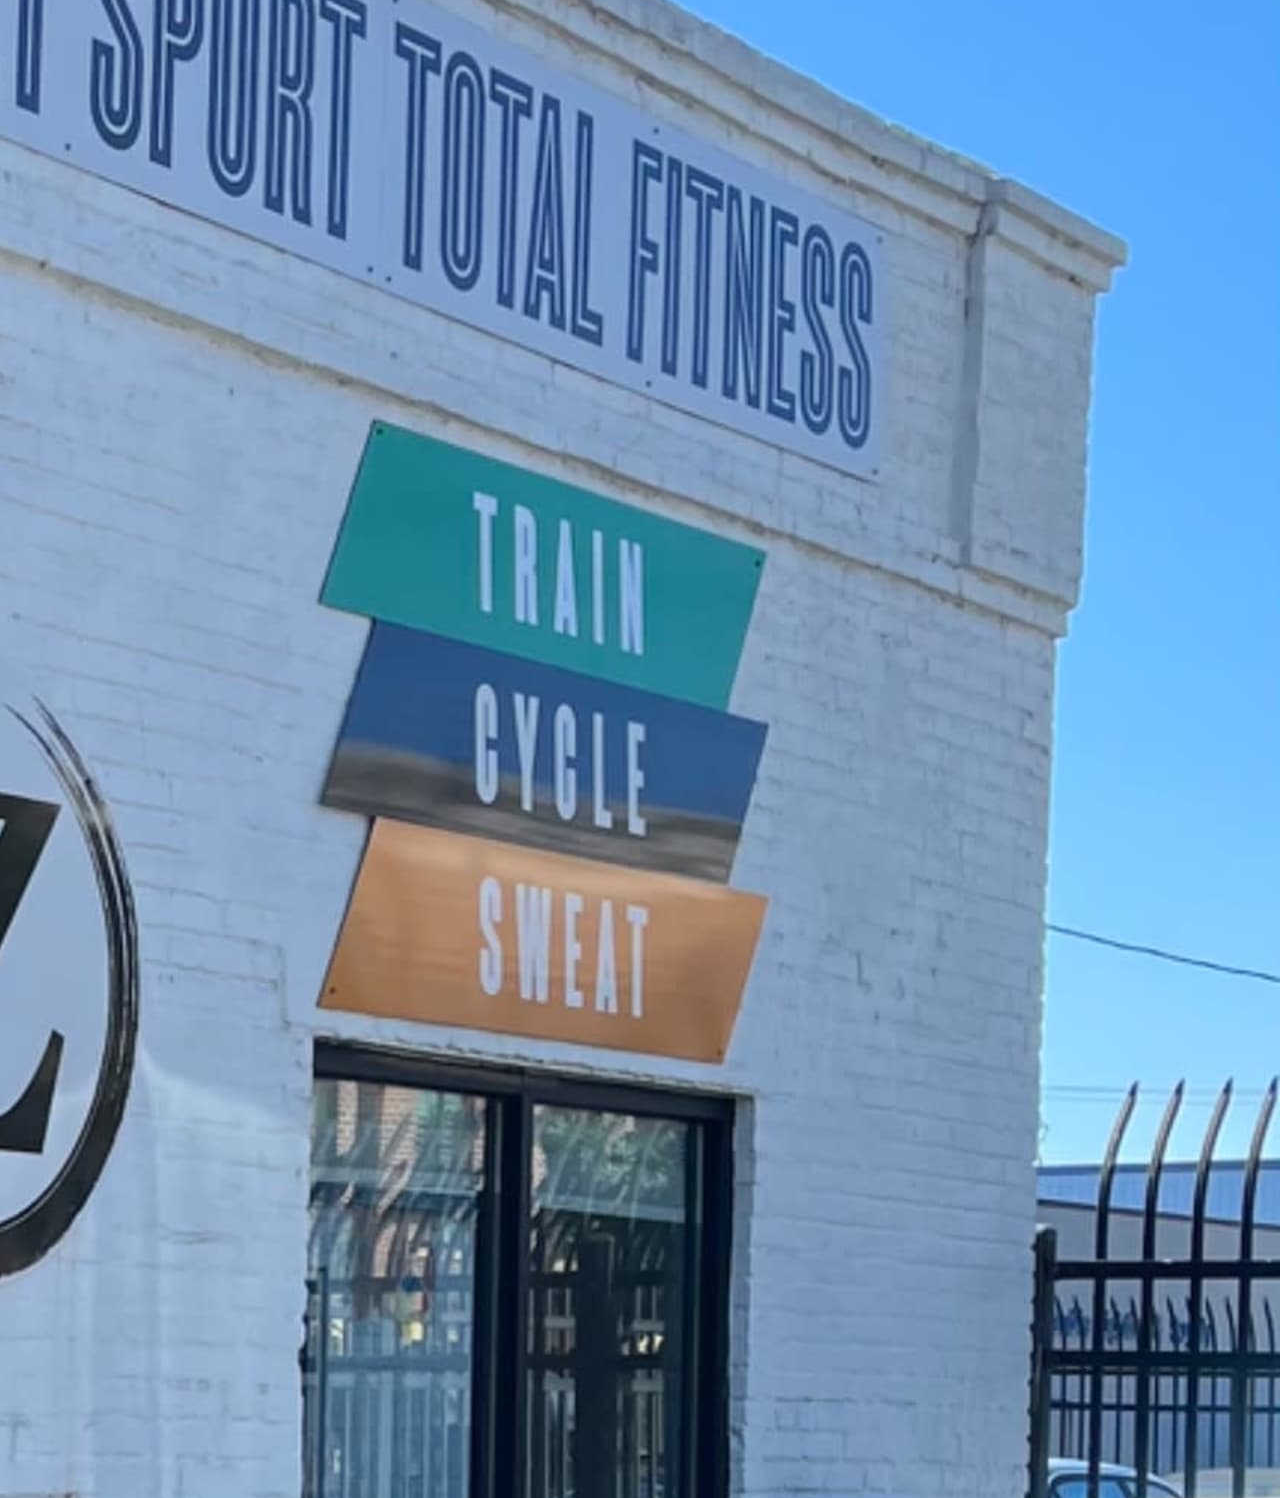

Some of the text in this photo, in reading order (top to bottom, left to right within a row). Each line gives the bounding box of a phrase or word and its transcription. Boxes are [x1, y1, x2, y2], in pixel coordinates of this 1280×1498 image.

[395, 21, 604, 348] TOTAL
[627, 139, 873, 449] FITNESS
[473, 492, 644, 655] TRAIN
[474, 683, 647, 836] CYCLE
[479, 877, 648, 1018] SWEAT
